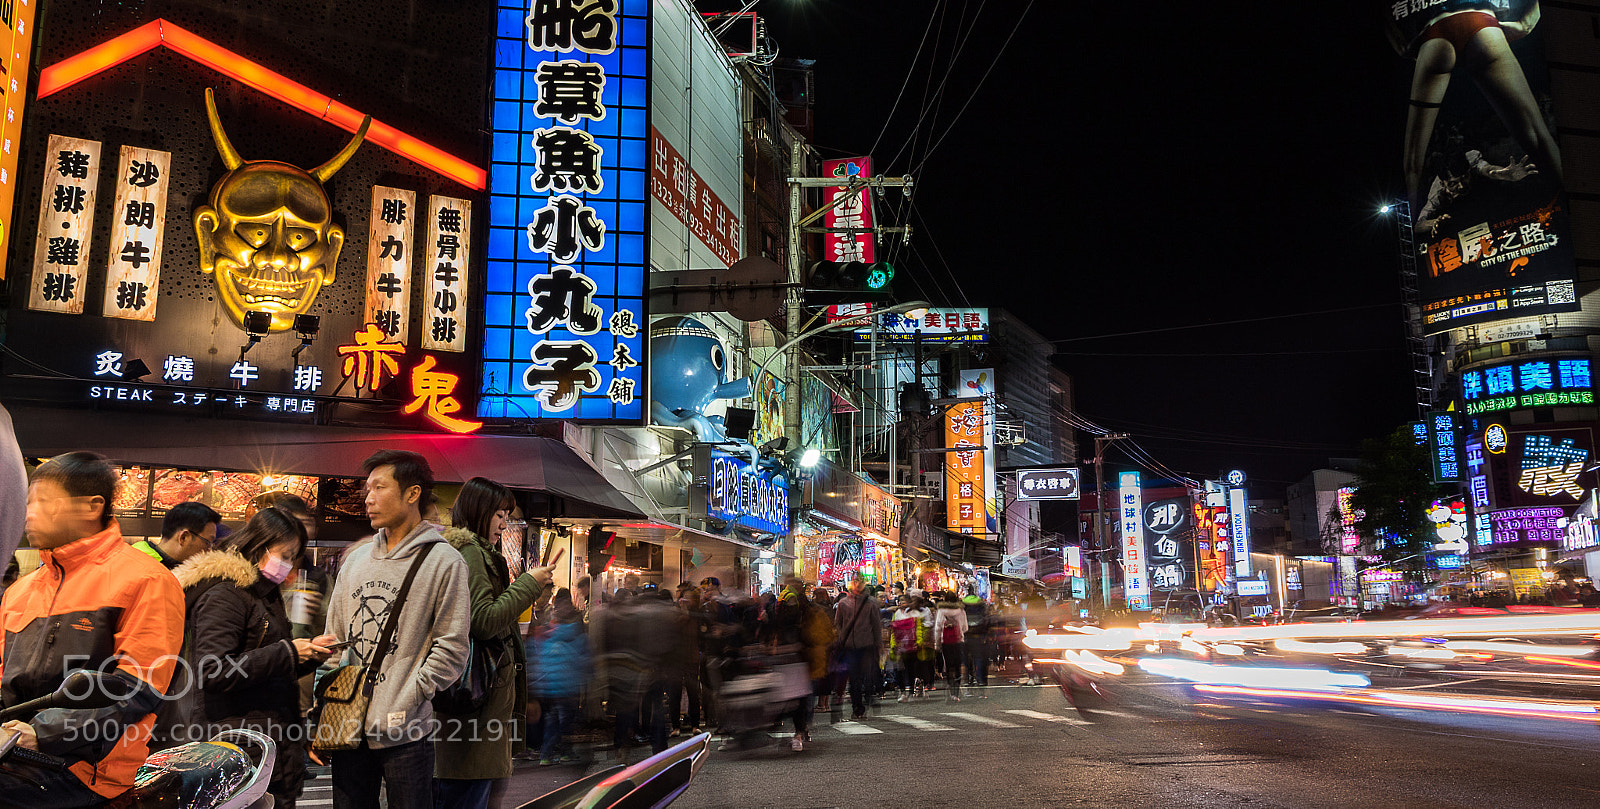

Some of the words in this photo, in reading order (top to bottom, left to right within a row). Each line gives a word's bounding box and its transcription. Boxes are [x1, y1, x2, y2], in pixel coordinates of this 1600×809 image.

[655, 137, 739, 252] 出租廣告出租
[116, 160, 160, 311] 沙朗牛排
[375, 197, 406, 337] 腓力牛排
[1480, 258, 1496, 268] CITY
[1497, 255, 1506, 263] OF
[1506, 251, 1520, 261] THE
[1520, 243, 1549, 257] UNDEAD
[432, 206, 462, 343] 無骨牛小排
[90, 386, 153, 402] STEAK
[173, 391, 248, 409] ステーキ
[94, 350, 323, 393] 炙燒牛排
[338, 322, 482, 434] 赤鬼
[1463, 360, 1591, 399] 洋碩美語
[1516, 507, 1563, 518] COSMETICS
[1149, 503, 1183, 588] 那個鍋
[365, 580, 374, 588] TO
[377, 580, 391, 591] THE
